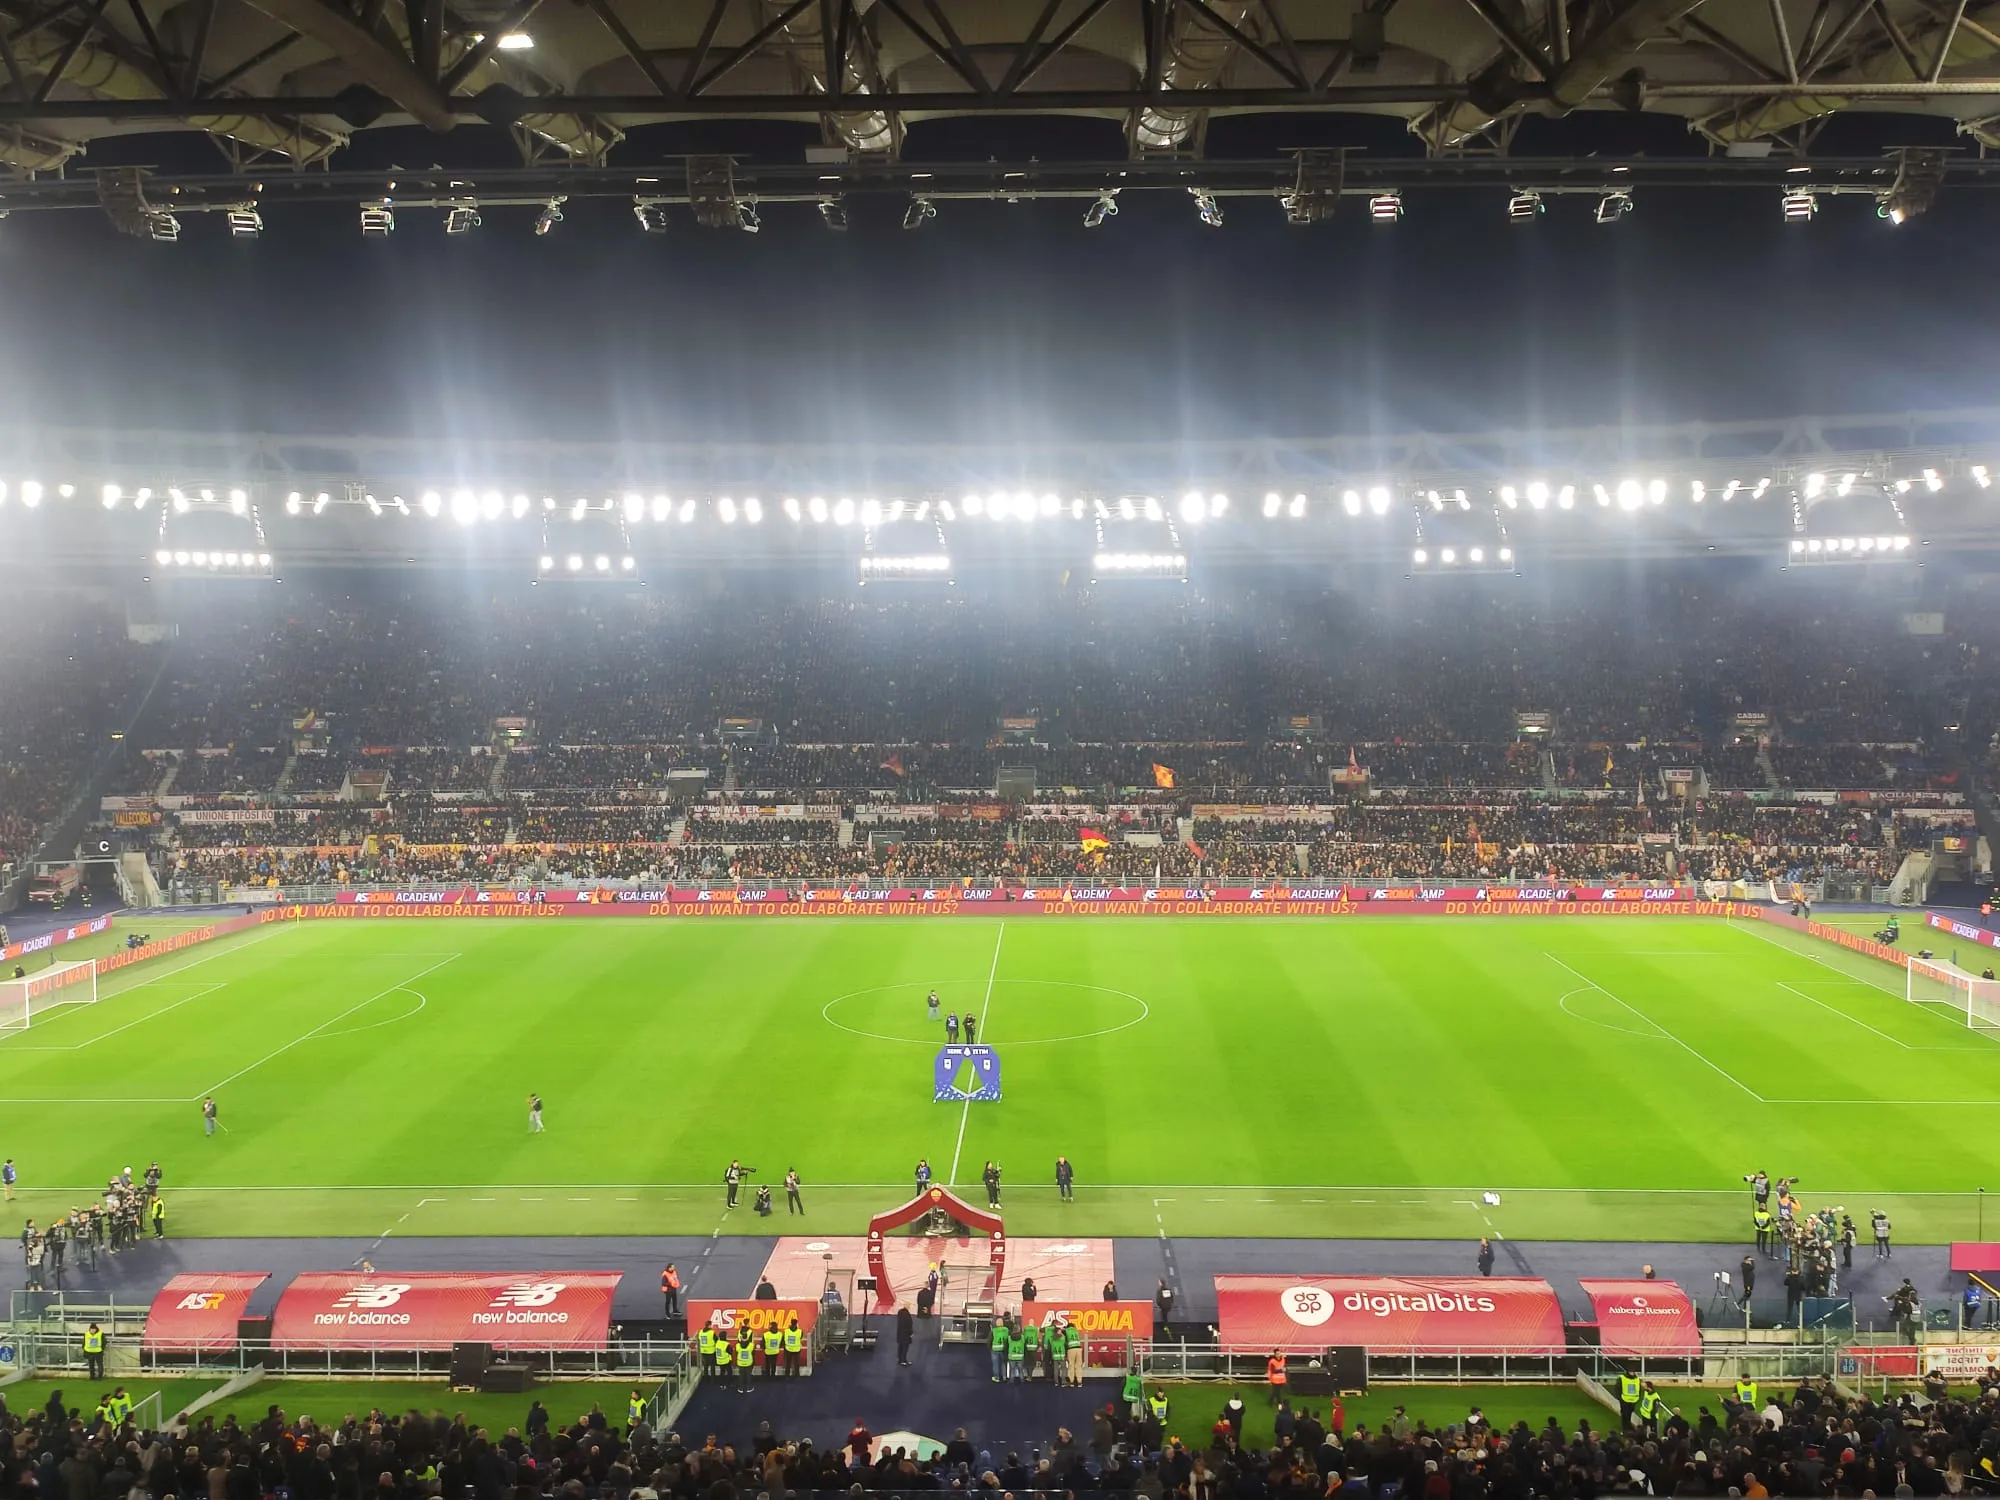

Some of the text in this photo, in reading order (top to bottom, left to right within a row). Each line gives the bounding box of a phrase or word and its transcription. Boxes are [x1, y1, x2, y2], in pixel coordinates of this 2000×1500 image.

[196, 810, 229, 820] UNIONE
[232, 810, 259, 820] TIFOSI
[808, 805, 838, 813] TIVOLI
[99, 840, 110, 852] C
[396, 892, 444, 902] ACADEMY
[964, 890, 992, 899] CAMP
[1292, 890, 1341, 899] ACADEMY
[1417, 890, 1445, 898] AMP
[1644, 888, 1675, 898] CAMP
[260, 904, 565, 922] DO YOU WANT TO COLLABORATE WITH US?
[650, 903, 958, 915] DO YOU WANT TO COLLABORATE WITH US?
[1044, 902, 1358, 914] DO YOU WANT TO COLLABORATE WITH US?
[1445, 902, 1467, 914] DO
[1472, 902, 1502, 914] YOU
[1508, 902, 1554, 914] WANT
[1558, 902, 1576, 914] TO
[1582, 902, 1690, 914] COLLABORATE
[1696, 903, 1736, 915] WITH
[90, 920, 106, 932] CAMP
[22, 935, 53, 953] ACADEMY
[1808, 922, 1820, 935] DO
[1822, 926, 1837, 942] YOU
[1840, 932, 1863, 950] WANT
[1863, 940, 1876, 954] TO
[97, 959, 108, 974] TO
[110, 939, 173, 969] COLLABORATE
[176, 934, 198, 948] WITH
[200, 926, 215, 940] US?
[176, 1292, 225, 1310] ASR
[1343, 1292, 1495, 1316] digitalbits
[472, 1310, 569, 1324] new balance
[1609, 1307, 1645, 1315] Auberge
[314, 1311, 411, 1325] new balance
